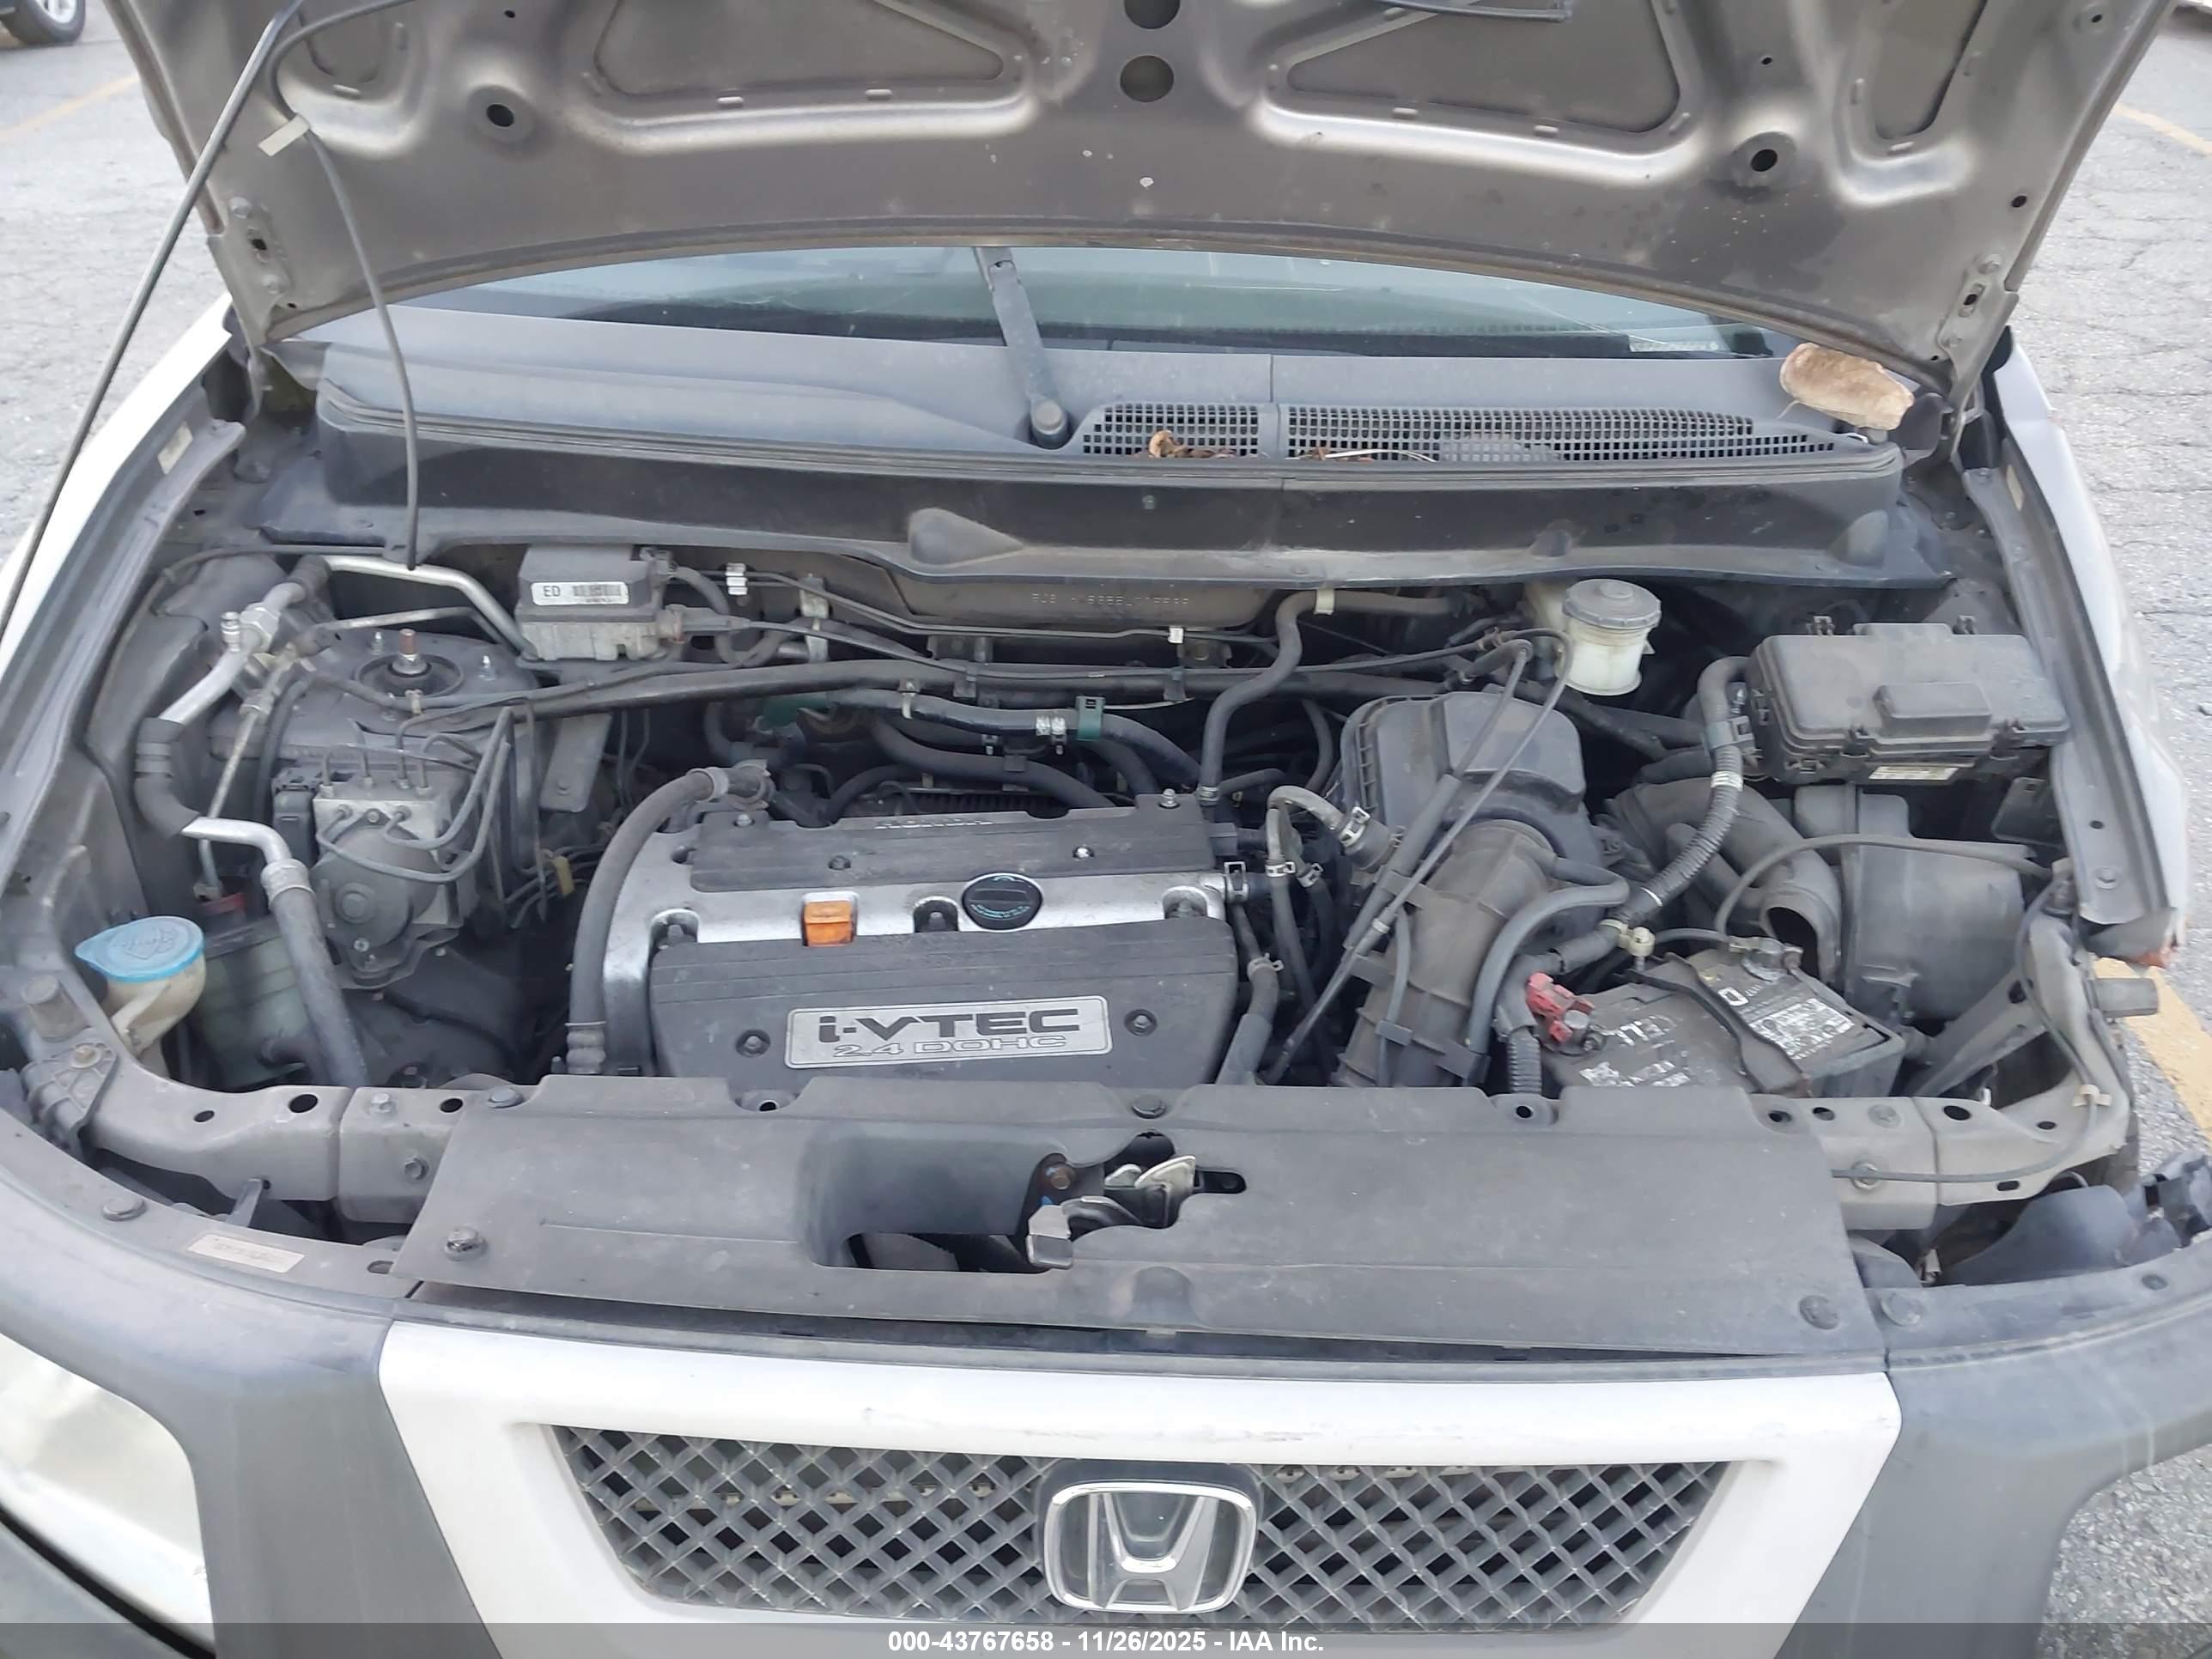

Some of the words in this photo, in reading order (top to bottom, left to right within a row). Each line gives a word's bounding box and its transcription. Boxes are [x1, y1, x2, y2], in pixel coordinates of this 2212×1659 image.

[543, 585, 561, 598] ED
[818, 1007, 1079, 1043] i-VTEC
[833, 1042, 904, 1058] 2.4
[914, 1035, 1067, 1054] DOHC
